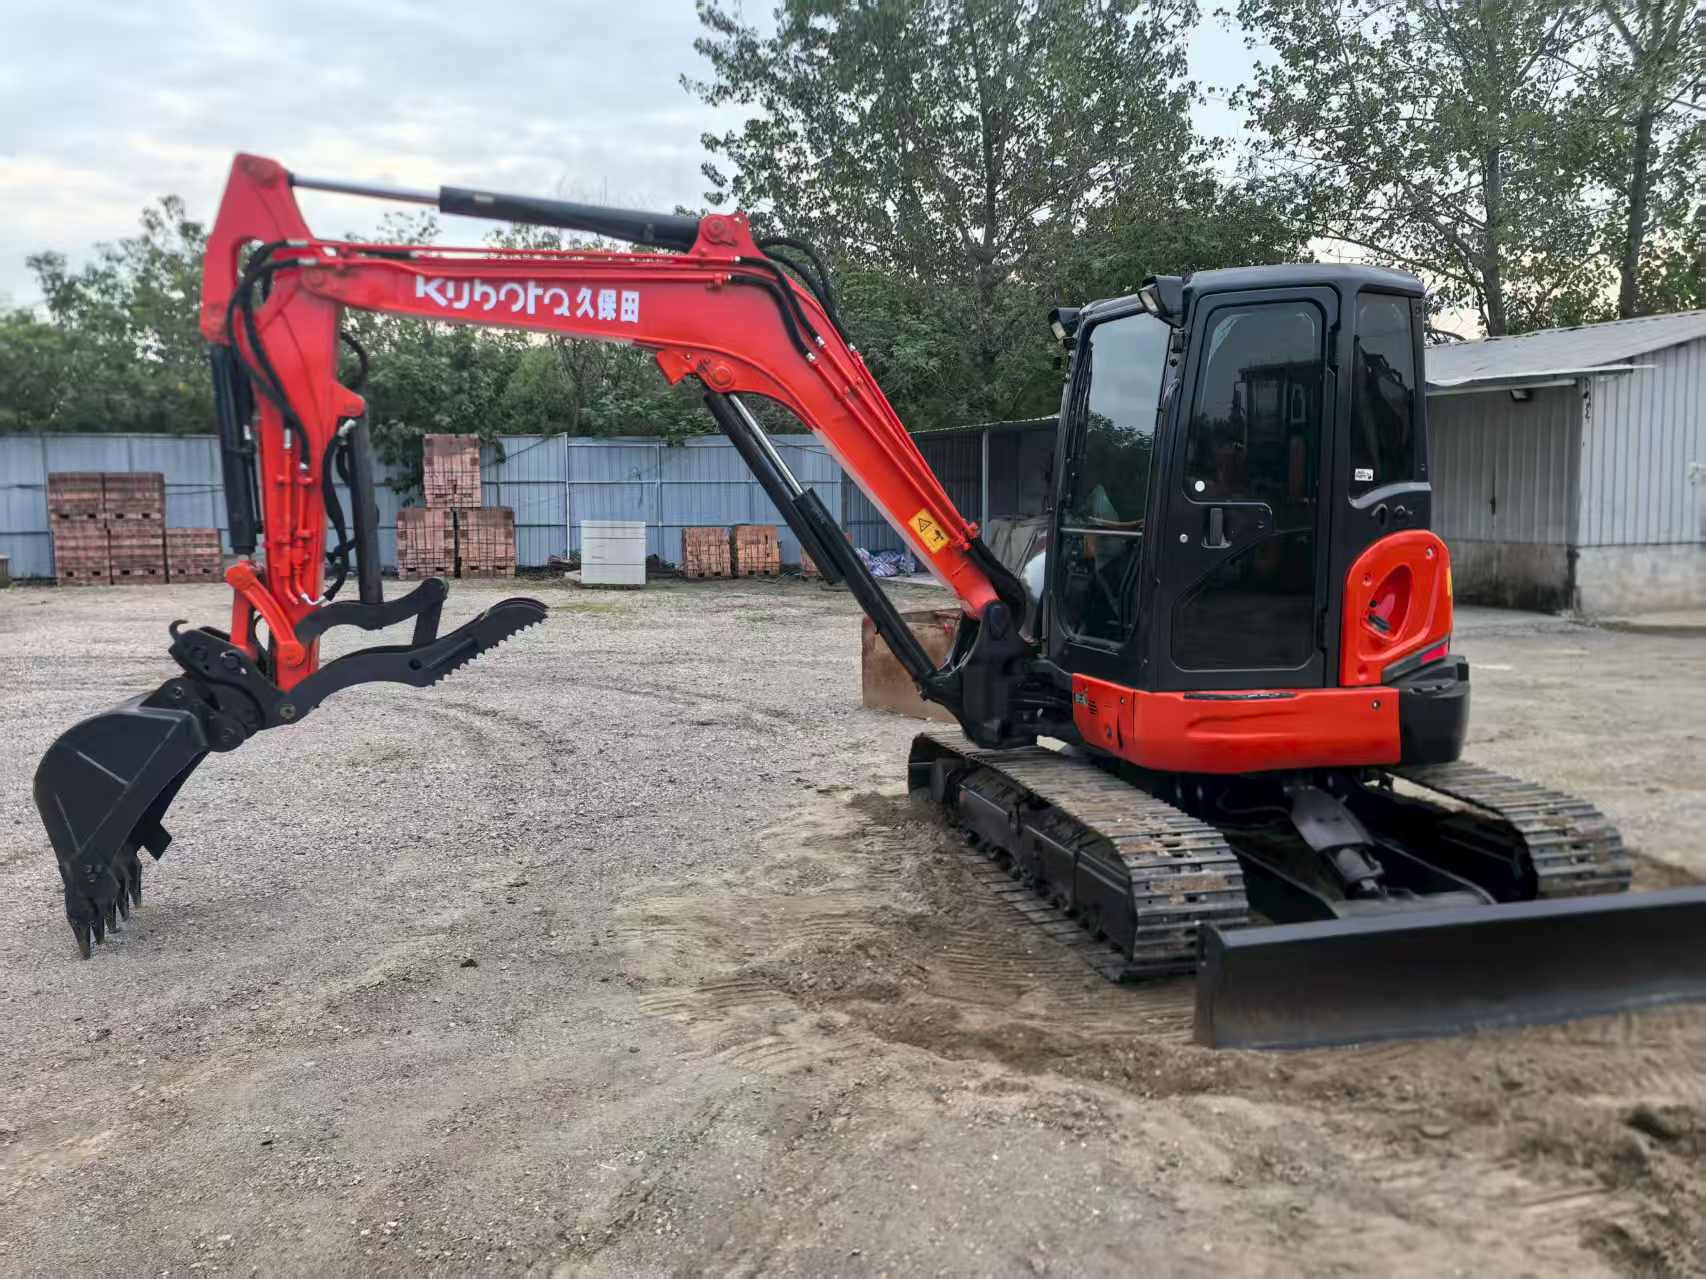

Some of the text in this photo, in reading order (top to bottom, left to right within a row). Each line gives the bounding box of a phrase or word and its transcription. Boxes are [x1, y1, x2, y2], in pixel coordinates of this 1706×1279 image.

[415, 275, 640, 323] Kubota 久保田
